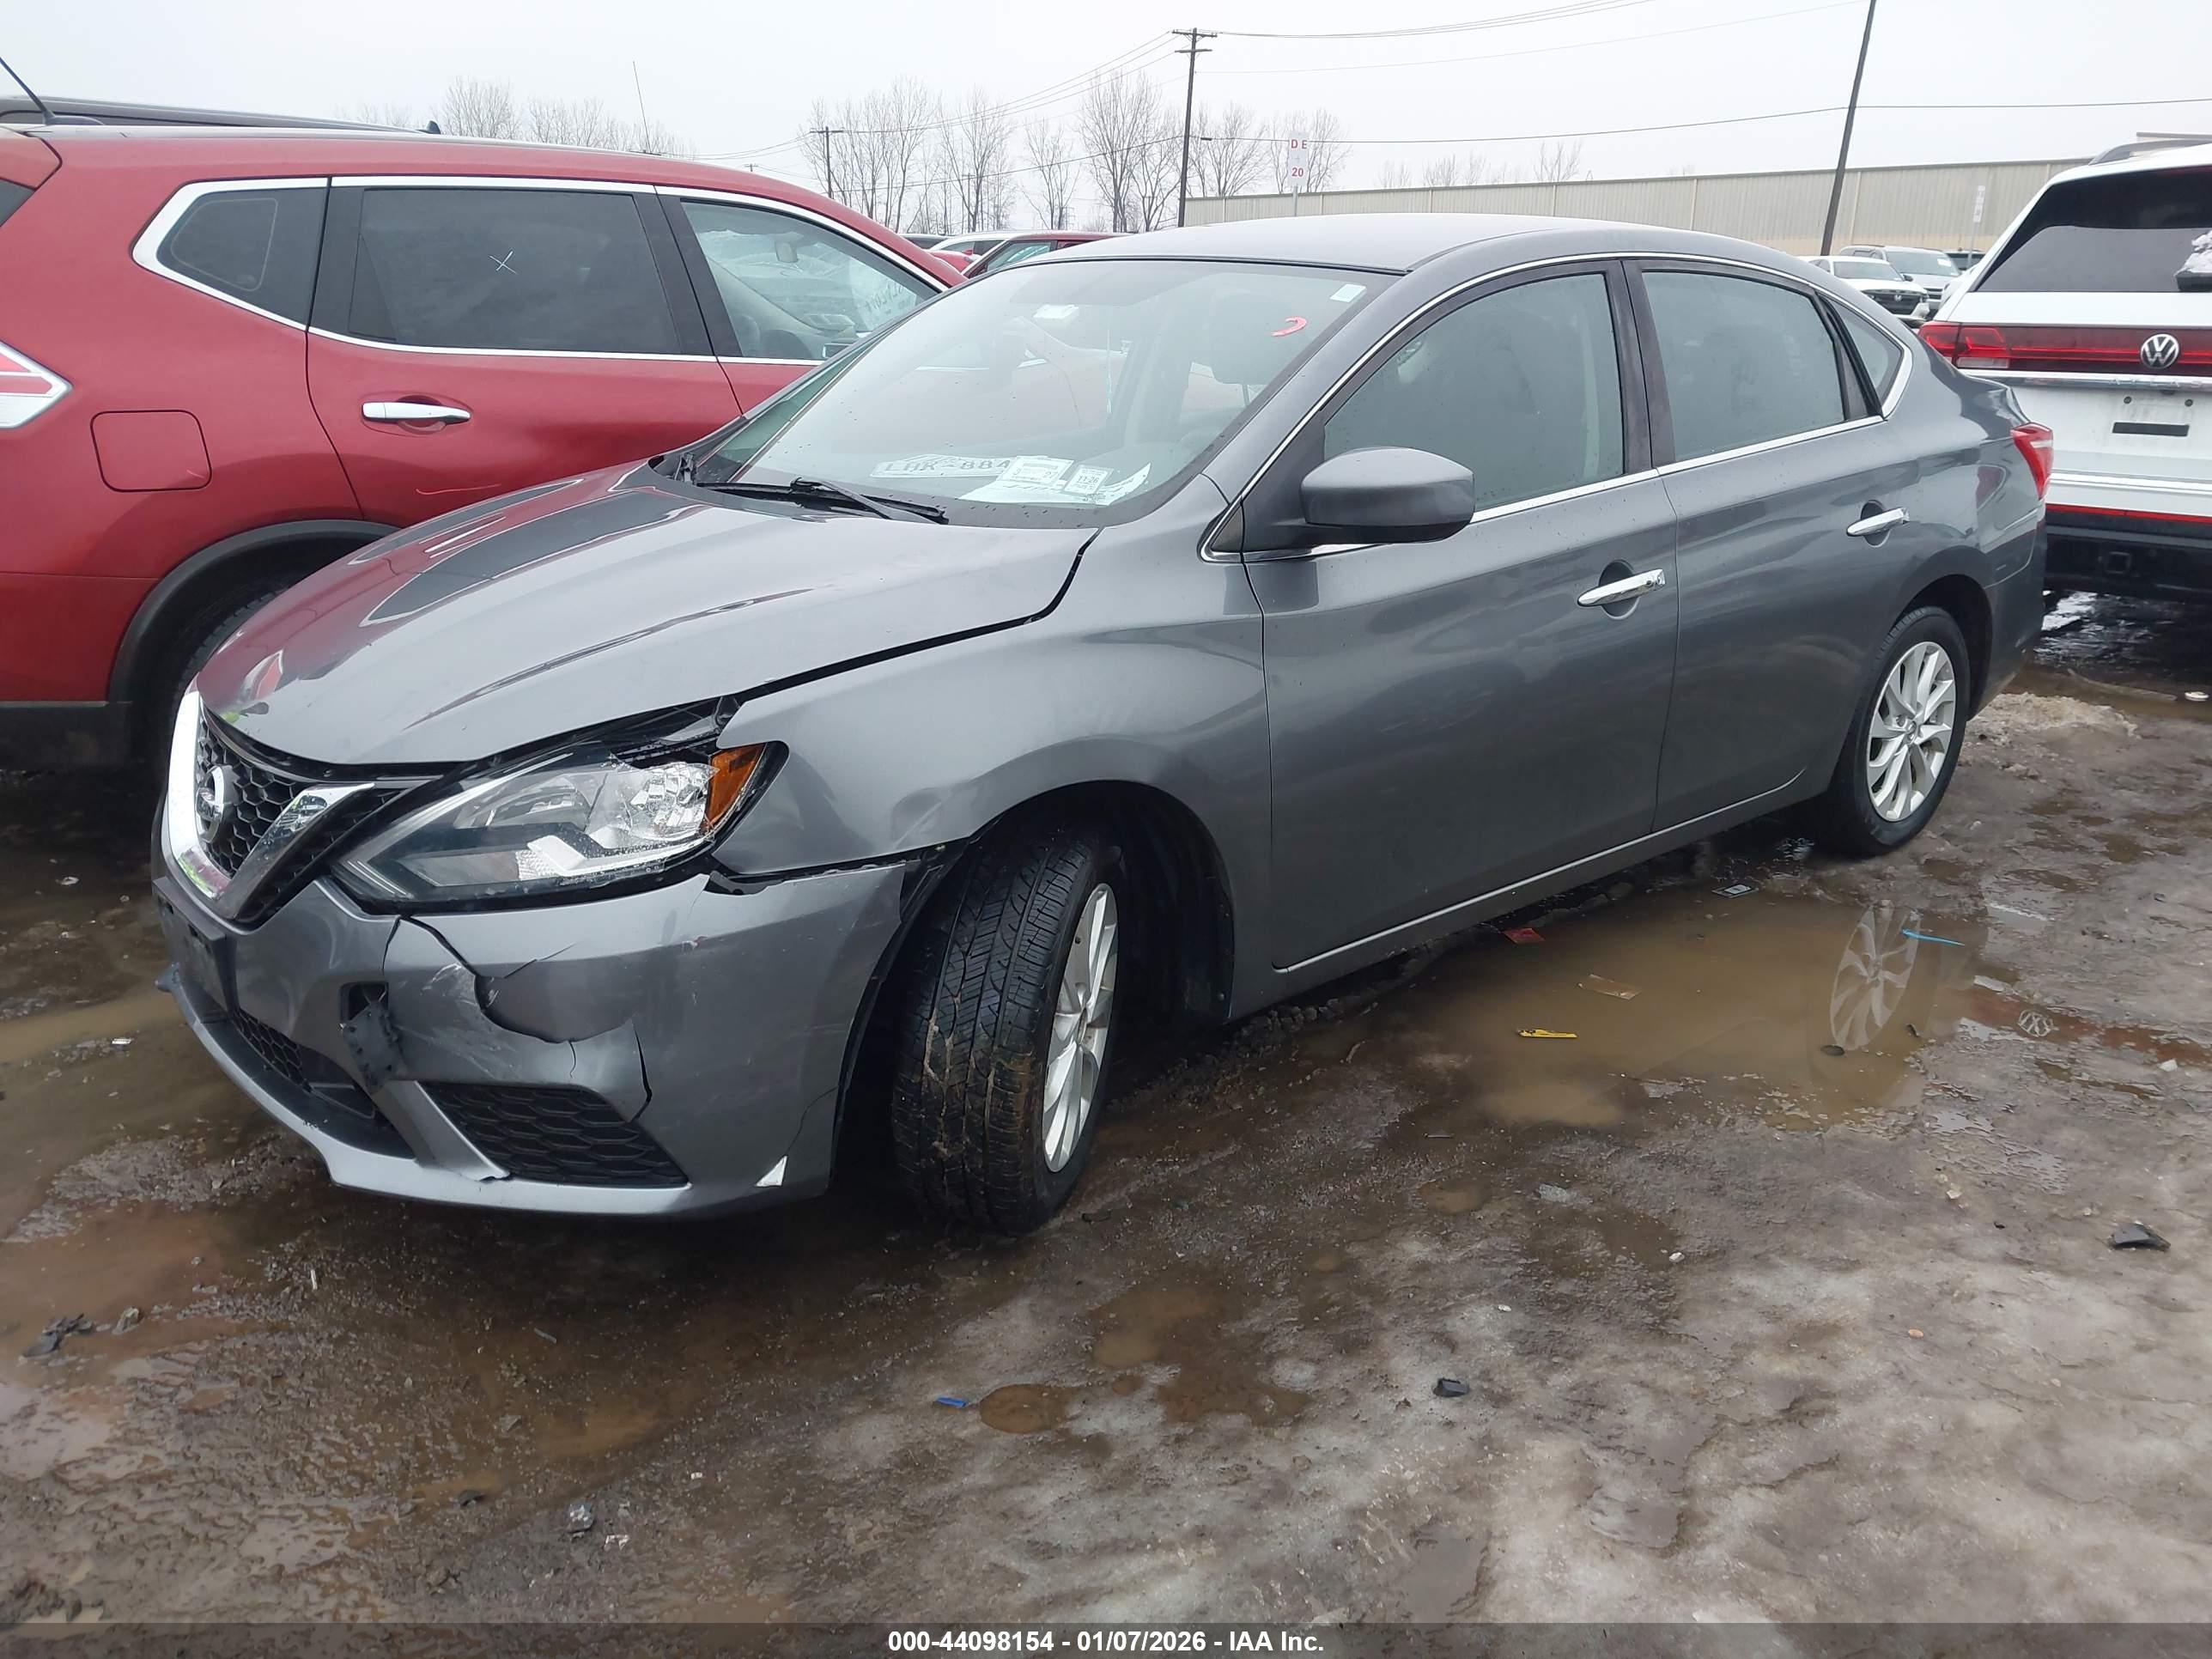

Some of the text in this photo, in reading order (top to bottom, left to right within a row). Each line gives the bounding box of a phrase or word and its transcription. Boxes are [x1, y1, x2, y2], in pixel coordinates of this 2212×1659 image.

[1291, 139, 1308, 149] D E
[1291, 167, 1304, 177] 20
